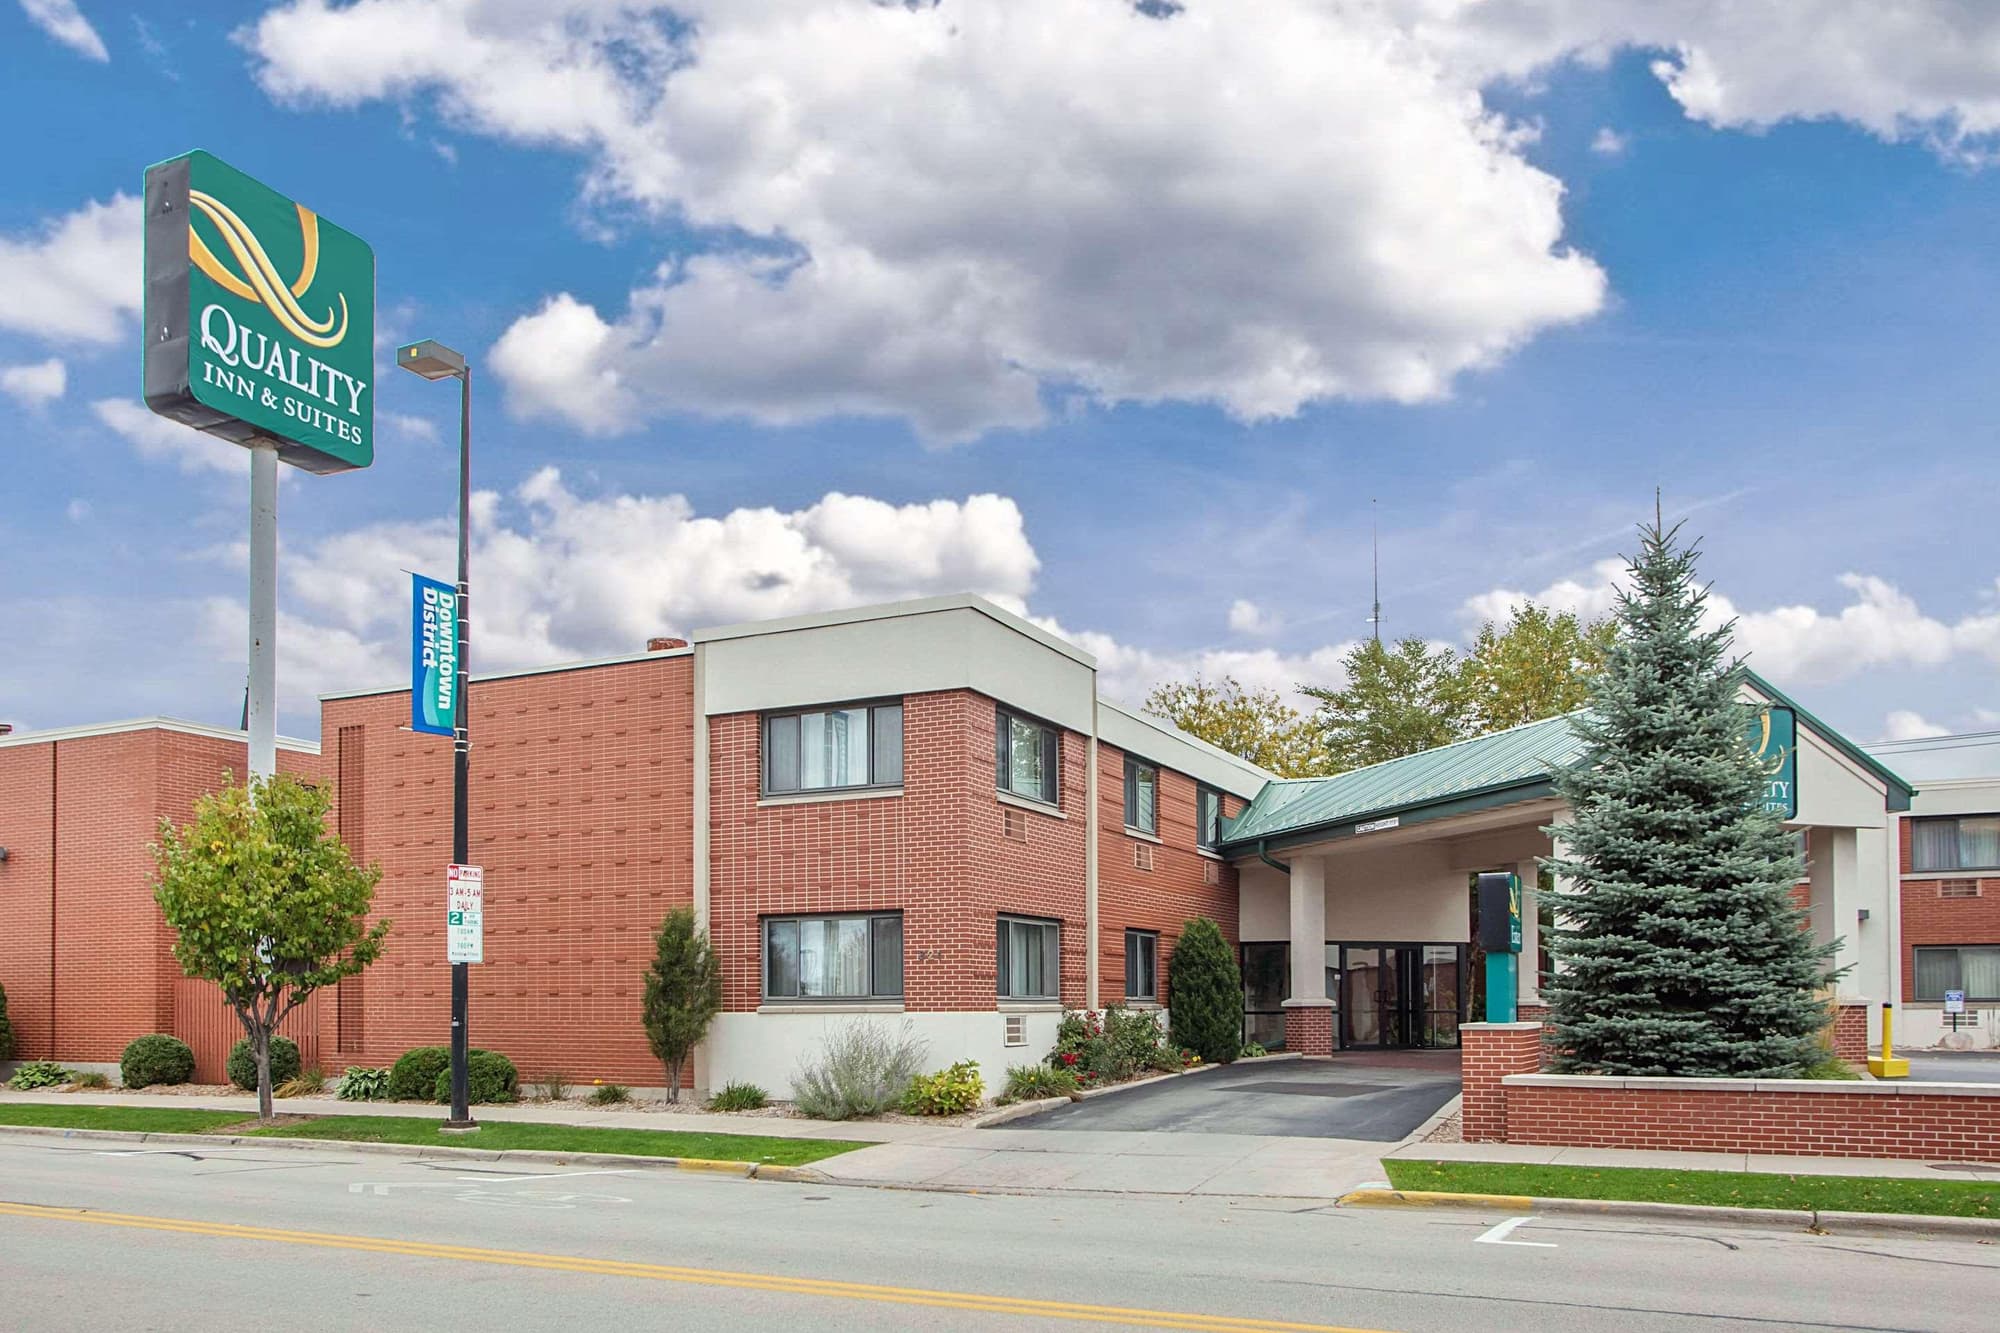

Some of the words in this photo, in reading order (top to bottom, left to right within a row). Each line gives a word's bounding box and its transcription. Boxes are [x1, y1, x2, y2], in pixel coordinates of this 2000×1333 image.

[200, 304, 366, 416] QUALITY
[203, 362, 255, 400] INN
[261, 387, 278, 409] &
[283, 398, 362, 445] SUITES
[422, 586, 438, 669] District
[438, 592, 456, 710] Downtown
[448, 868, 458, 878] NO
[451, 912, 460, 924] 2
